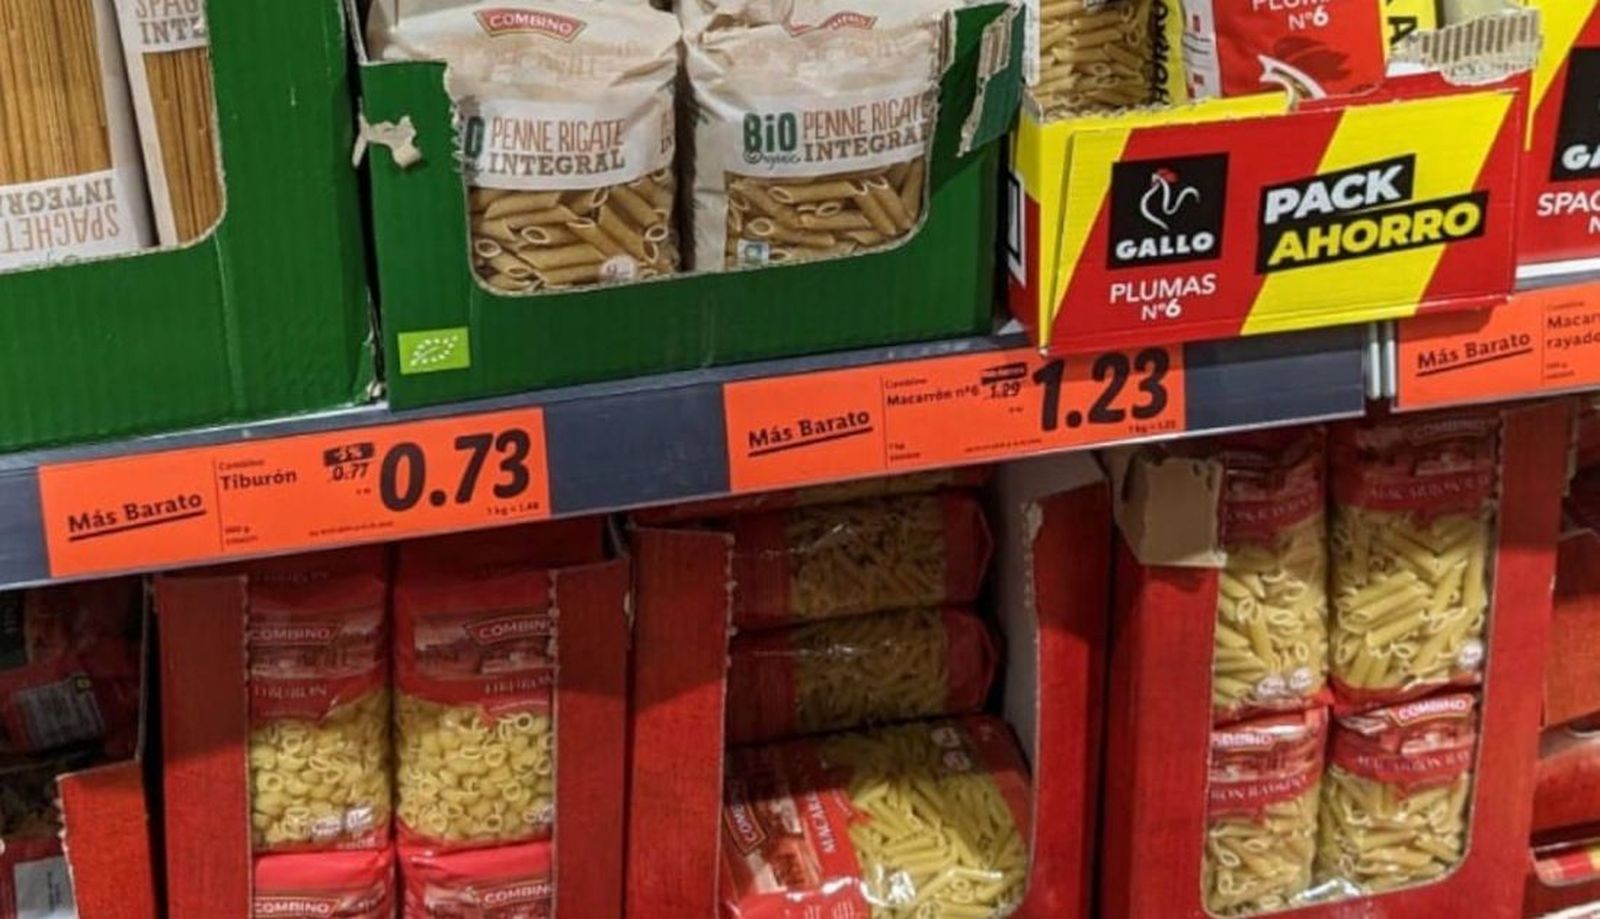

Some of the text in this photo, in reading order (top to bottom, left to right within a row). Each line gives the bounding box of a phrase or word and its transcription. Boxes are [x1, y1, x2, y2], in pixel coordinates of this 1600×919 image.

[489, 13, 573, 35] COMBINO
[492, 117, 552, 152] PENNE
[558, 118, 625, 152] RIGATE
[803, 106, 866, 140] PENNE
[489, 150, 625, 175] INTEGRAL
[1264, 164, 1404, 225] PACK
[1115, 231, 1215, 260] GALLO
[1267, 202, 1481, 266] AHORRO
[1110, 273, 1217, 304] PLUMAS
[1417, 333, 1531, 370] Más Barato
[1032, 347, 1171, 432] 1.23
[749, 410, 871, 449] Más Barato
[220, 469, 297, 491] Tiburón
[379, 428, 531, 513] 0.73
[68, 493, 203, 533] Más Barato
[1399, 699, 1467, 719] COMBINO
